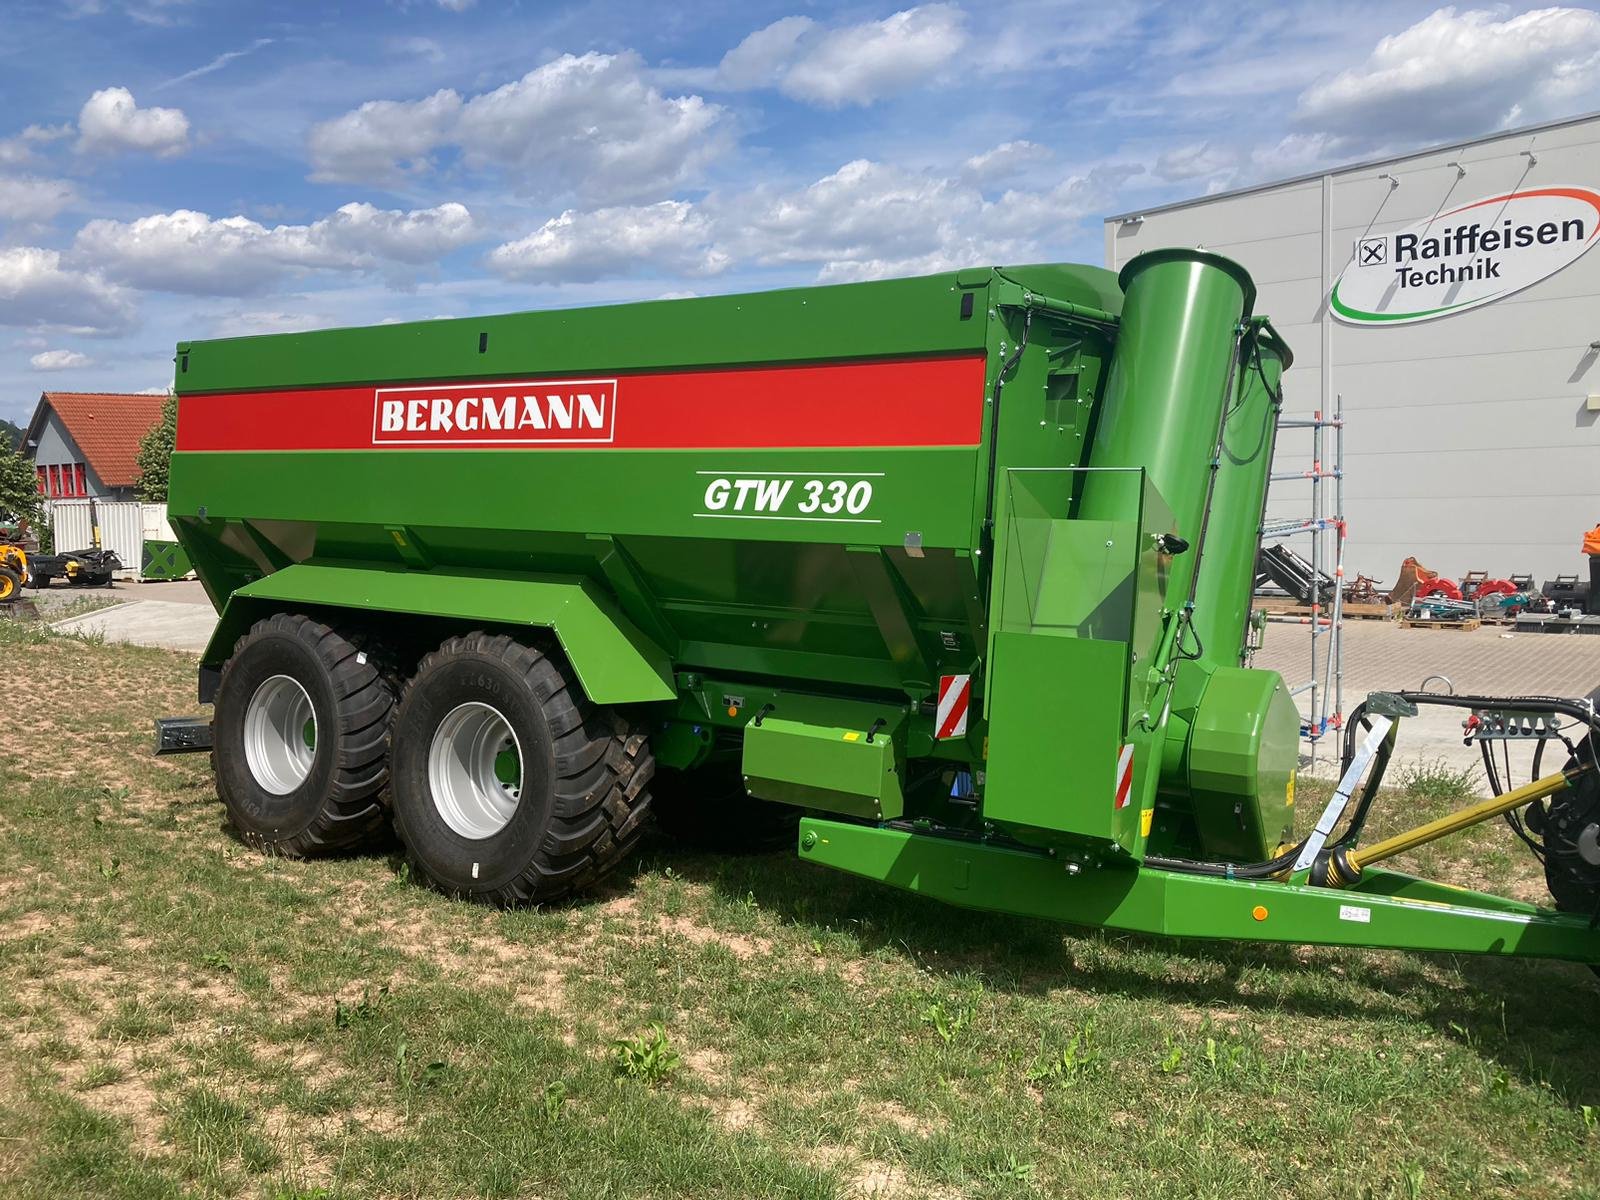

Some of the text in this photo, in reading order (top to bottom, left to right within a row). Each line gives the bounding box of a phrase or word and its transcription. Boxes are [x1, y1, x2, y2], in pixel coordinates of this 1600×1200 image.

[1395, 218, 1583, 262] Raiffeisen
[1396, 258, 1501, 288] Technik
[381, 394, 605, 433] BERGMANN
[703, 478, 873, 514] GTW 330
